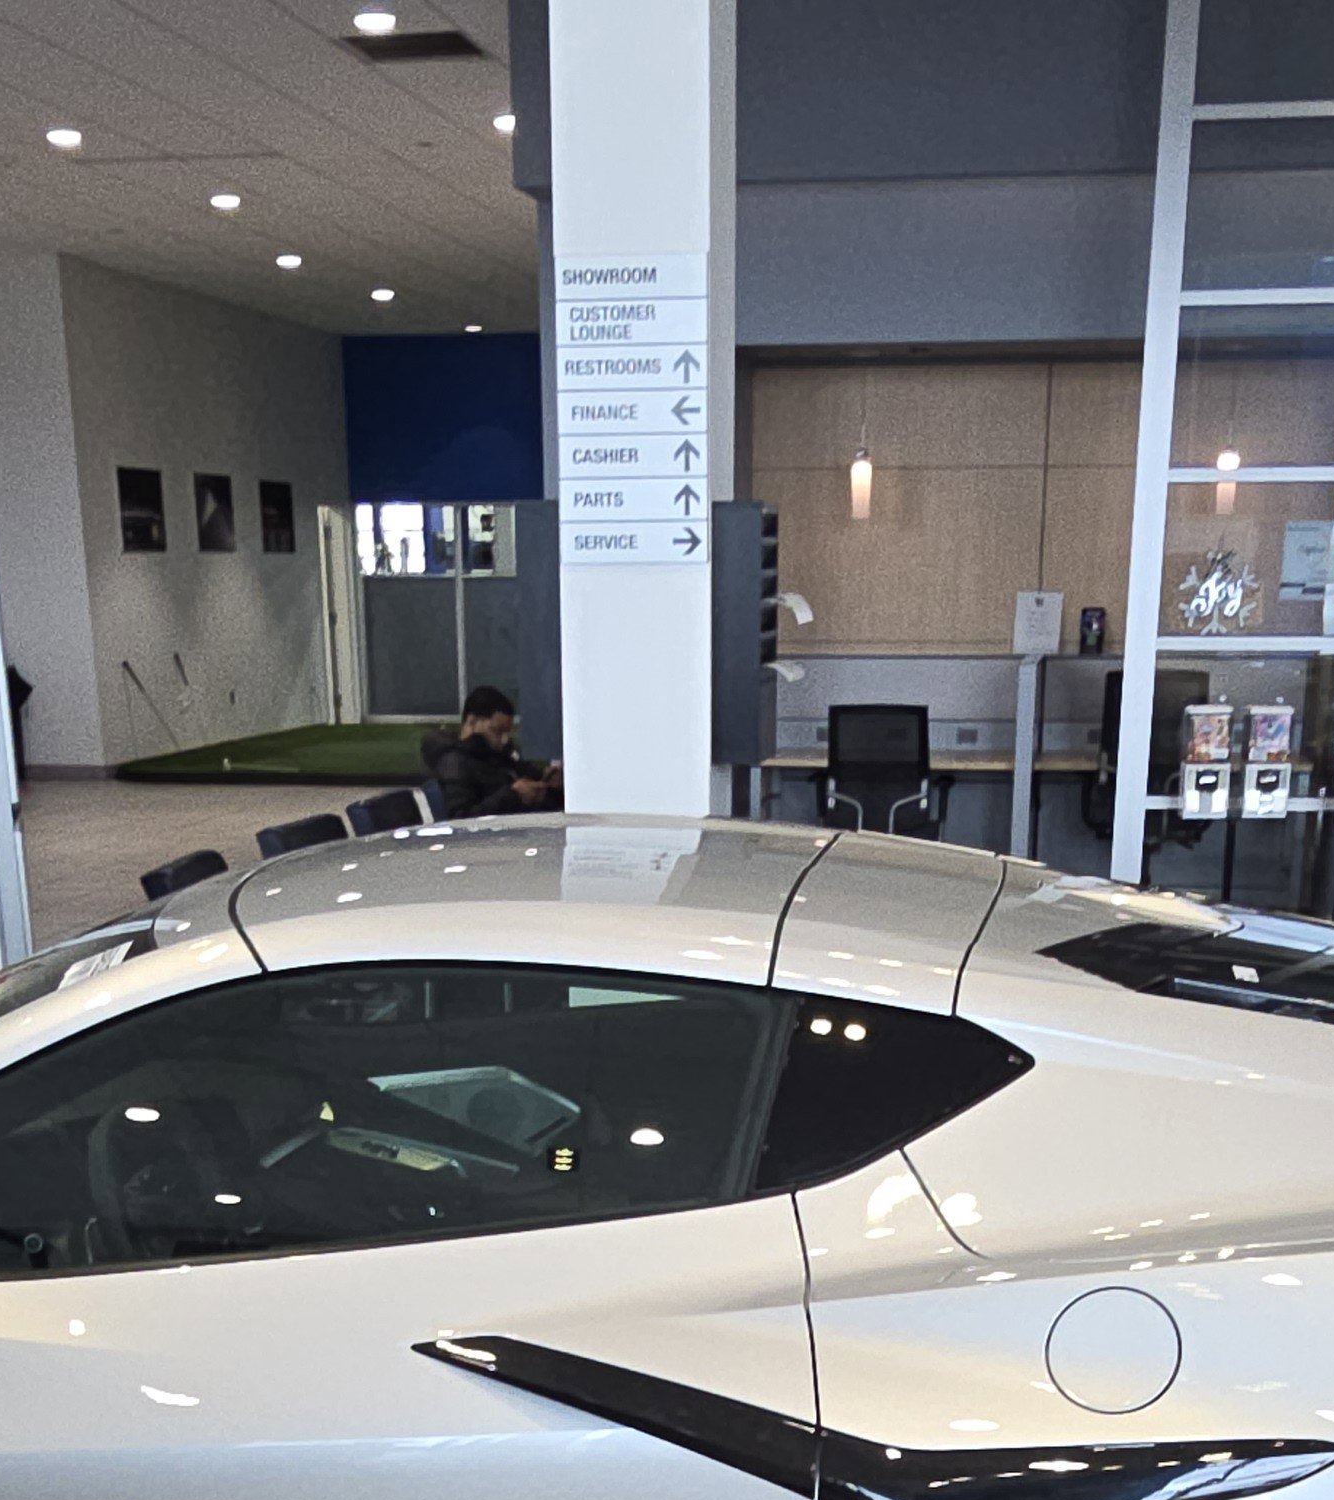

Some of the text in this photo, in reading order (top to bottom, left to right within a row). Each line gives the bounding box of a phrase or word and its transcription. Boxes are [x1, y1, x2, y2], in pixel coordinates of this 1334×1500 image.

[563, 267, 657, 286] SHOWROOM
[569, 304, 656, 323] CUSTOMER
[570, 323, 633, 341] LOUNGE
[565, 357, 662, 376] RESTROOMS
[571, 404, 638, 422] FINANCE
[572, 448, 639, 465] CASHIER
[573, 491, 624, 509] PARTS
[574, 534, 639, 551] SERVICE
